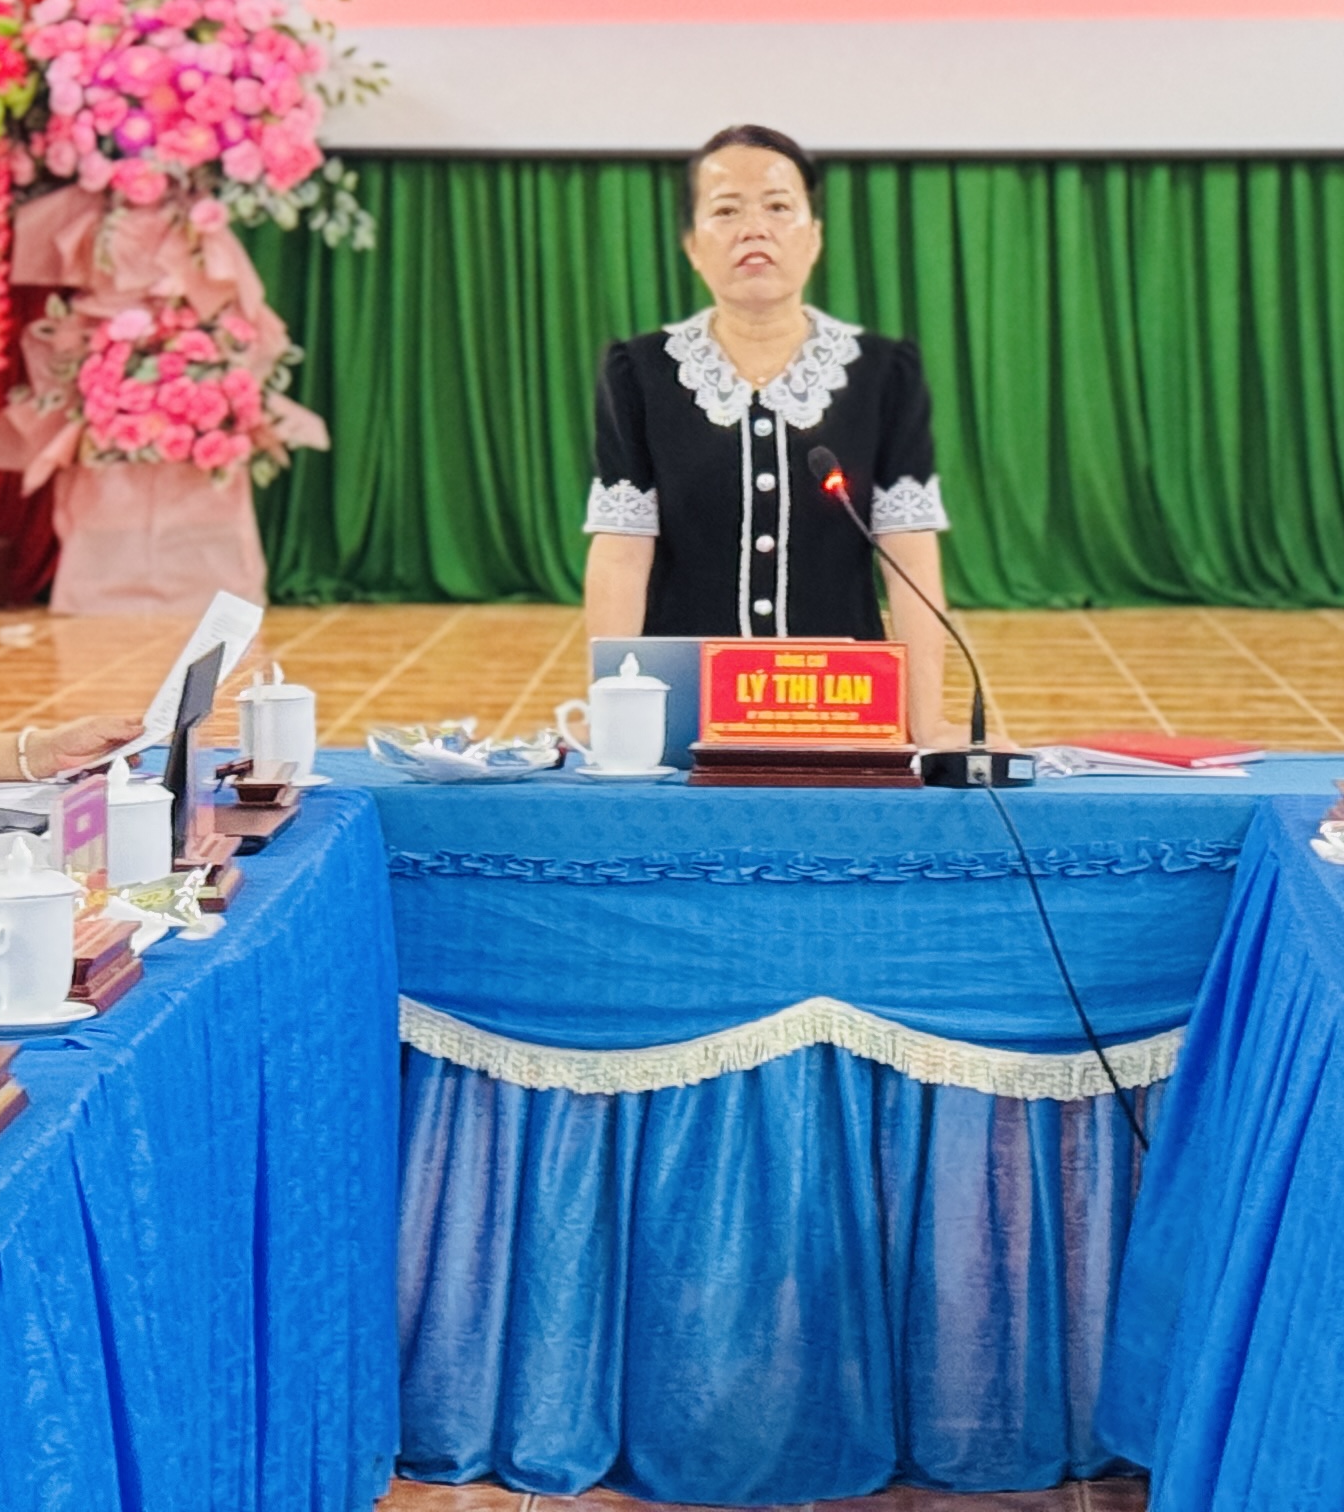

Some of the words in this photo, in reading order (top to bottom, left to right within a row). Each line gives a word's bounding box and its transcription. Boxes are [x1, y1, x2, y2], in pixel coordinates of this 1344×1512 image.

[737, 669, 769, 703] LÝ
[772, 674, 818, 710] THỊ
[823, 674, 873, 704] LAN
